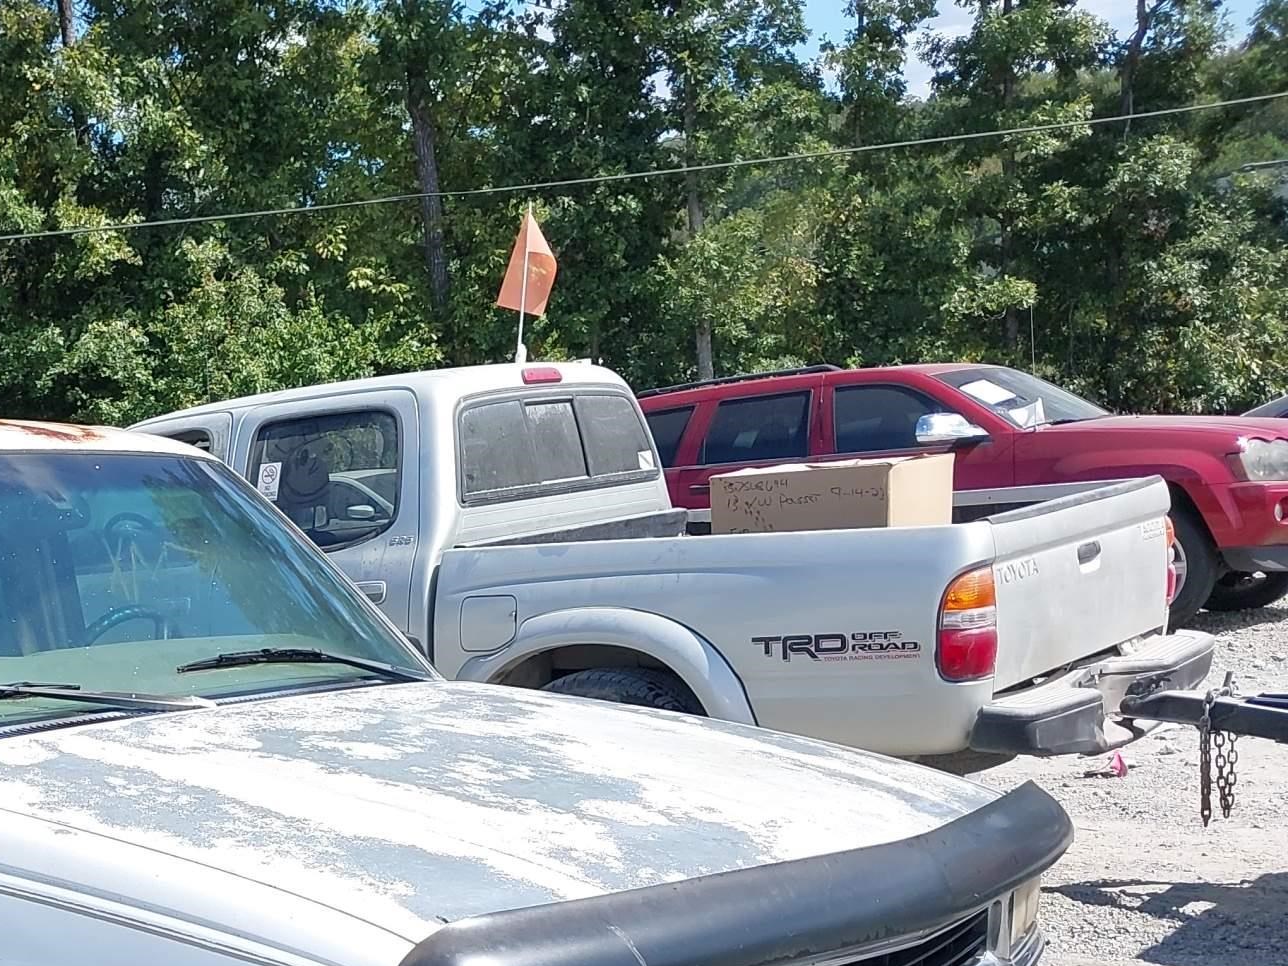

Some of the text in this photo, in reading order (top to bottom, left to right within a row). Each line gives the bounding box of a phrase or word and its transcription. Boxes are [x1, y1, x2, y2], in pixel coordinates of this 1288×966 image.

[998, 560, 1039, 584] TOYOTA
[751, 633, 849, 662] TRD
[851, 641, 921, 653] ROAD
[874, 653, 921, 661] DEVELOPMENT
